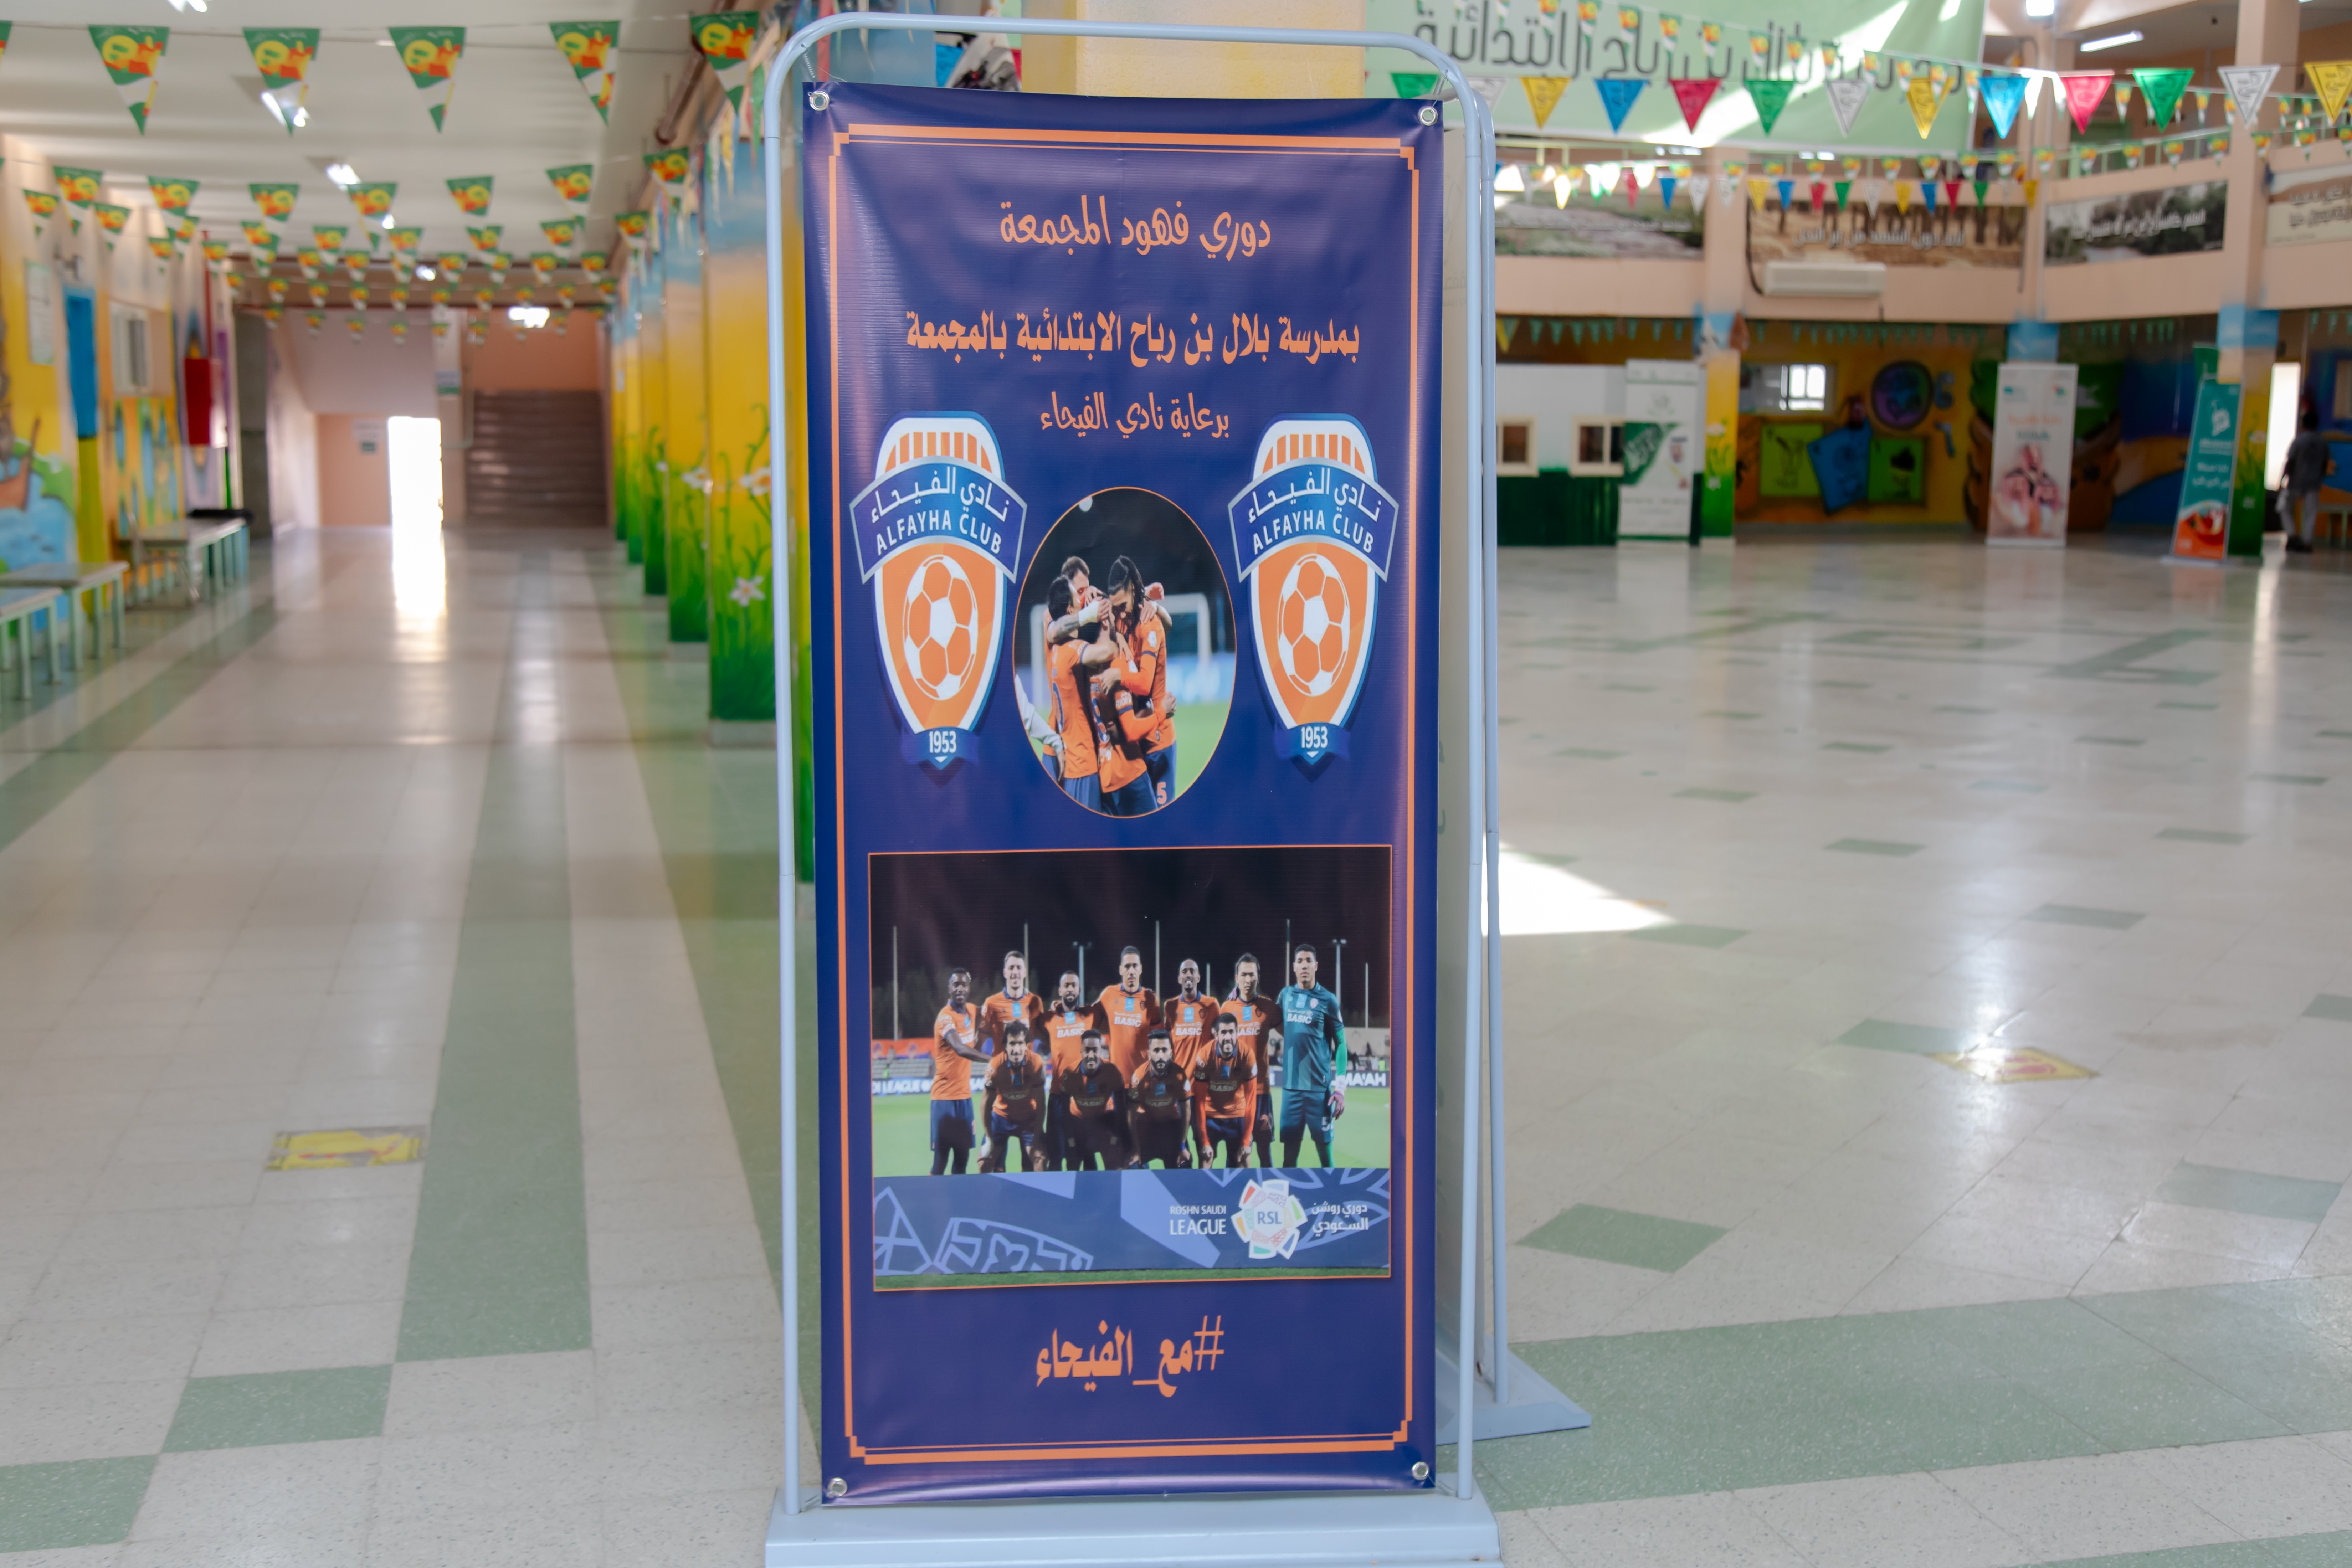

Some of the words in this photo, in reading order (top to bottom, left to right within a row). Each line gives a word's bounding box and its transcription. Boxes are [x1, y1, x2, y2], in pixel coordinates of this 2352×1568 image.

[1001, 195, 1111, 255] المجمعة
[1122, 201, 1188, 255] فهود
[1200, 212, 1270, 261] دوري
[907, 310, 1006, 363] بالمجمعة
[1017, 308, 1121, 361] الابتدائية
[1131, 314, 1176, 367] رباح
[1185, 313, 1213, 365] بن
[1223, 313, 1269, 364] بلال
[1279, 317, 1359, 364] بمدرسة
[1041, 392, 1108, 437] الفيحاء
[1116, 392, 1163, 438] نادي
[1171, 393, 1229, 438] برعاية
[872, 466, 956, 523] الفيحاء
[960, 482, 1009, 523] نادي
[1248, 467, 1330, 524] الفيحاء
[1334, 483, 1382, 523] نادي
[876, 509, 951, 555] ALFAYHA
[959, 514, 1002, 554] CLUB
[1253, 509, 1325, 555] ALFAYHA
[1332, 513, 1373, 553] CLUB
[929, 730, 957, 754] 1953
[1301, 725, 1328, 749] 1953
[1157, 782, 1167, 805] 5
[1057, 1028, 1085, 1038] BASIC
[1114, 1016, 1141, 1027] BASIC
[1176, 1027, 1202, 1036] BASIC
[1237, 1027, 1261, 1036] ASIC
[1287, 1013, 1312, 1024] BASIC
[882, 1080, 917, 1094] LEAGUE
[1170, 1206, 1199, 1215] ROSHN
[1201, 1205, 1227, 1215] SAUDI
[1170, 1218, 1227, 1236] LEAGUE
[1258, 1211, 1282, 1225] RSL
[1311, 1201, 1341, 1216] روشن
[1313, 1218, 1369, 1237] السعودي
[1342, 1204, 1368, 1218] دوري
[1037, 1315, 1224, 1397] #مع_الفيحاء
